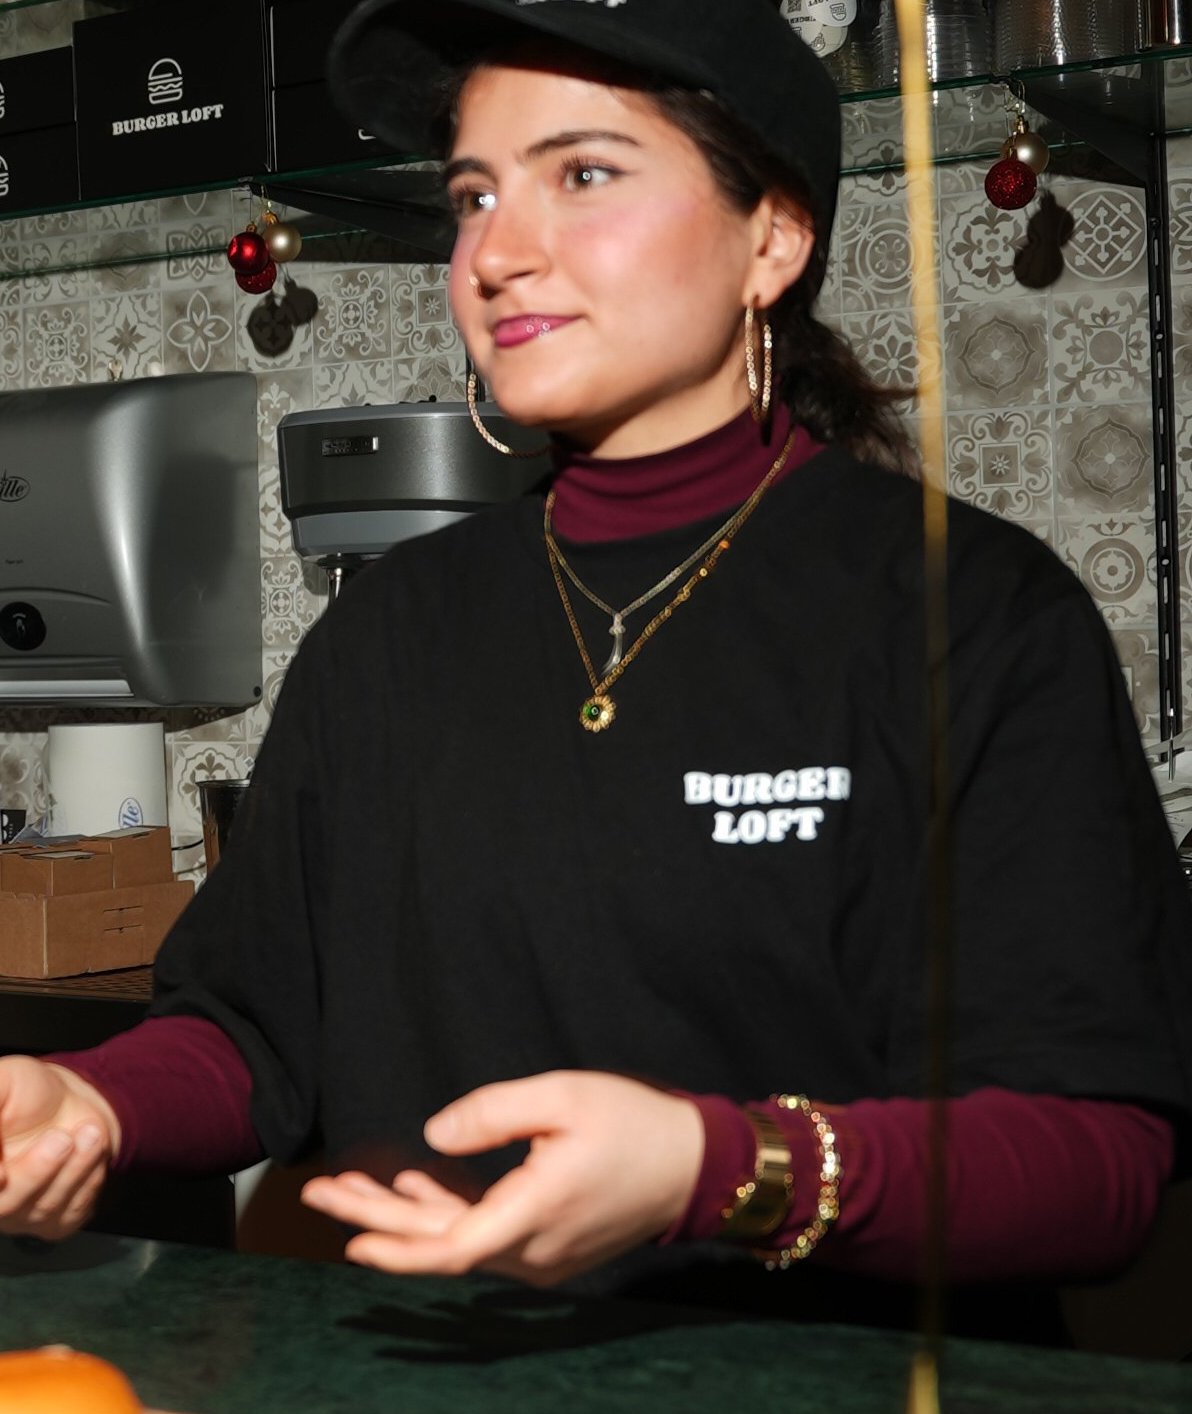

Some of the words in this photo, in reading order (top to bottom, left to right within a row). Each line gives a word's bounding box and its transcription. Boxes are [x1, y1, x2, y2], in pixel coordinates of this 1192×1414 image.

[112, 112, 180, 135] BURGER
[181, 104, 224, 124] LOFT
[683, 766, 852, 807] BURGER
[123, 805, 139, 828] lle
[711, 806, 825, 844] LOFT
